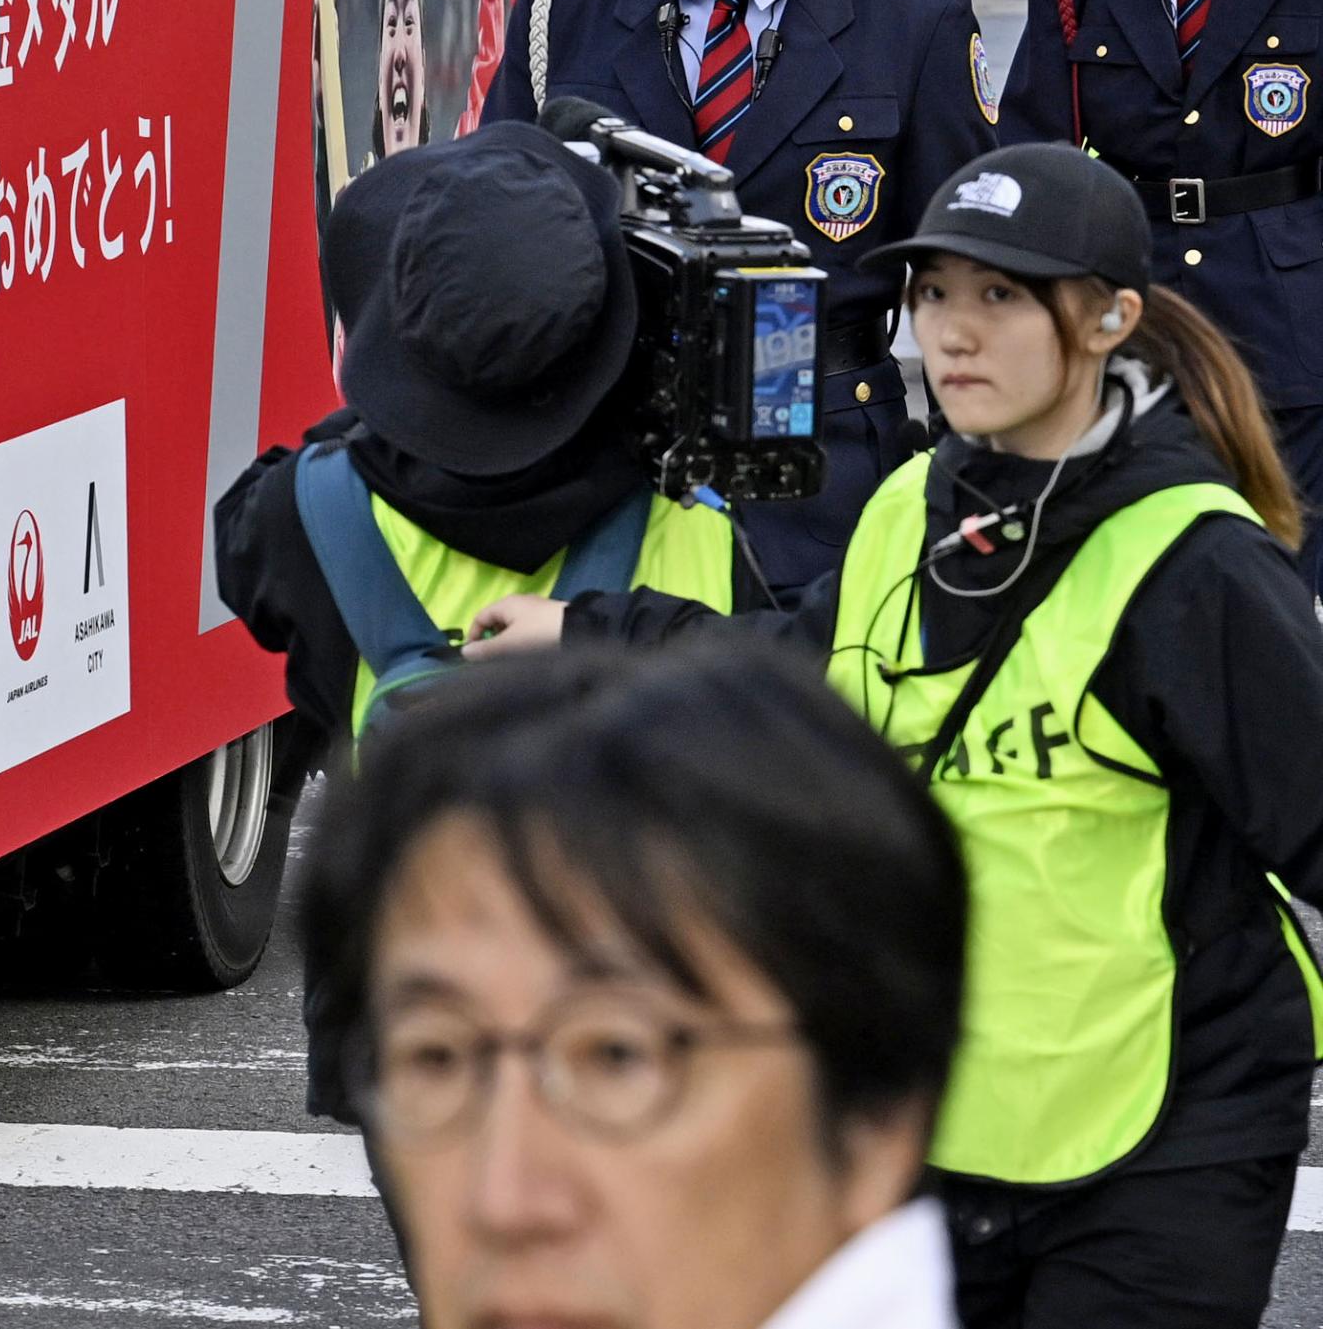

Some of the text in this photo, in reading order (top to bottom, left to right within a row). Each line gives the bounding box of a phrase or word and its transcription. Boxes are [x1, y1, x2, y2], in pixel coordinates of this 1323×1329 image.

[18, 614, 39, 646] JAL
[74, 609, 115, 644] ASAHIKAWA
[87, 649, 104, 674] CITY
[6, 674, 48, 704] JAPAN AIRLINES
